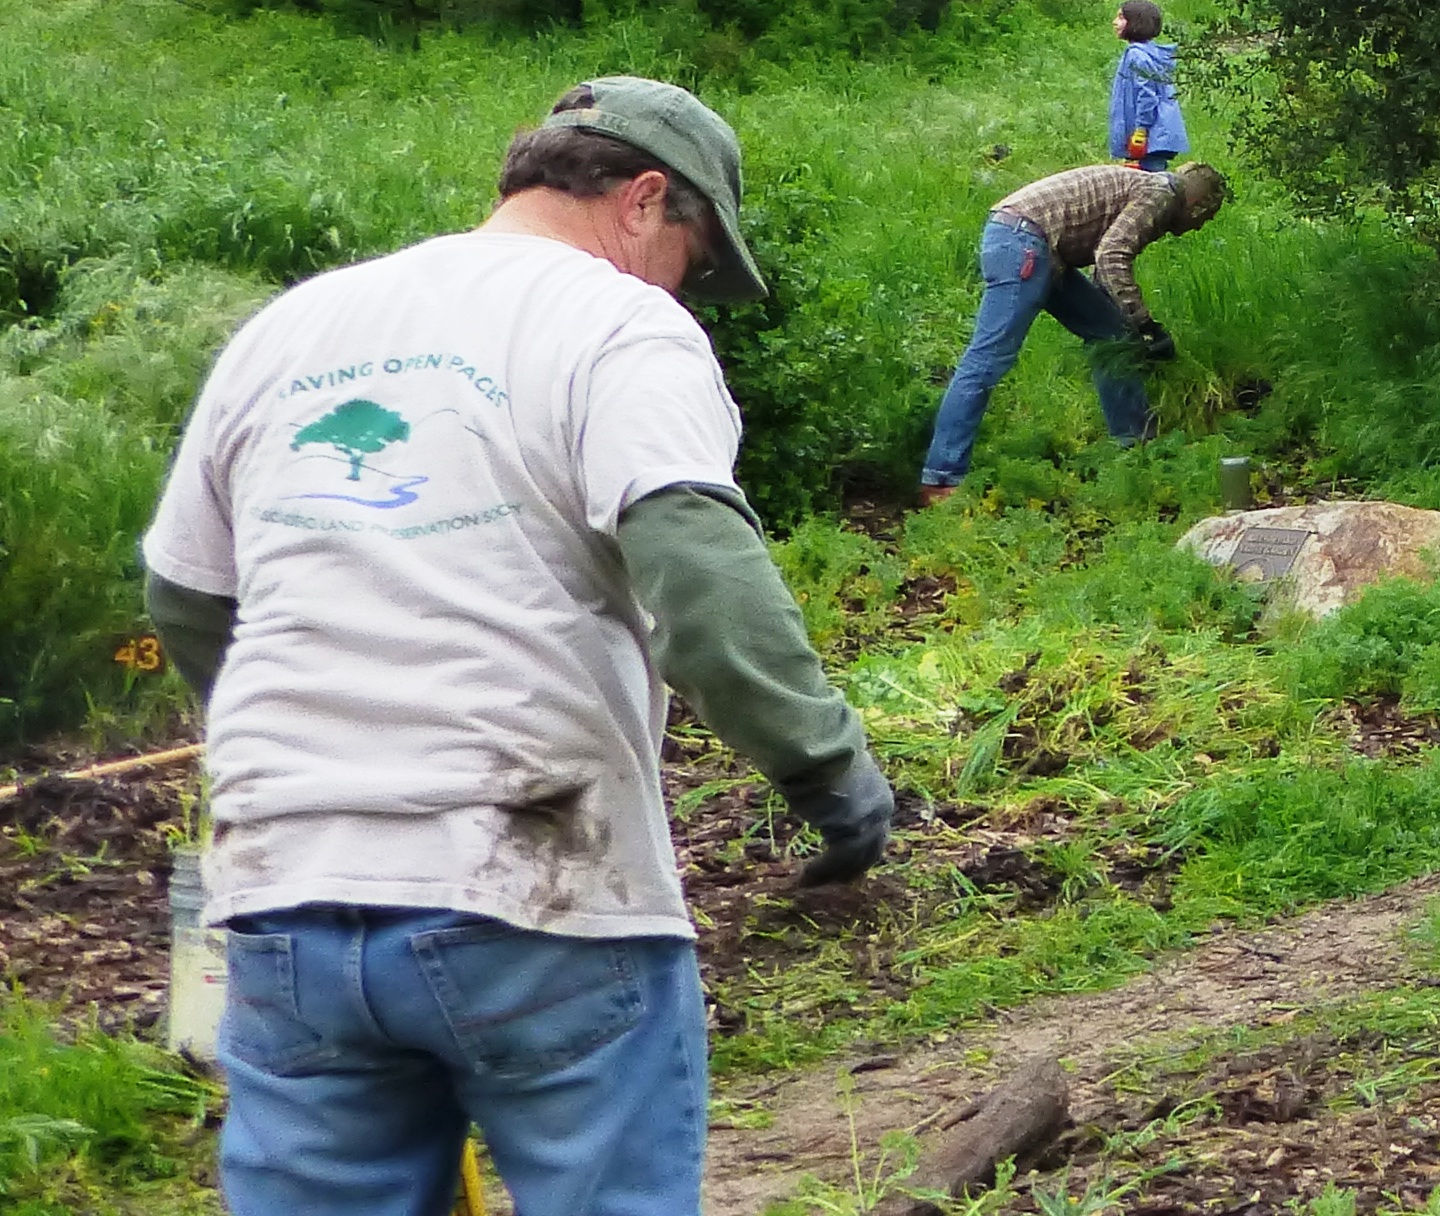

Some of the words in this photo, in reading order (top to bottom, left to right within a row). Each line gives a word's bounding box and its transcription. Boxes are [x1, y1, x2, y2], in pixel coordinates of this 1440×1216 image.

[383, 353, 442, 374] OPEN
[447, 353, 508, 408] PACES
[114, 638, 159, 670] 43
